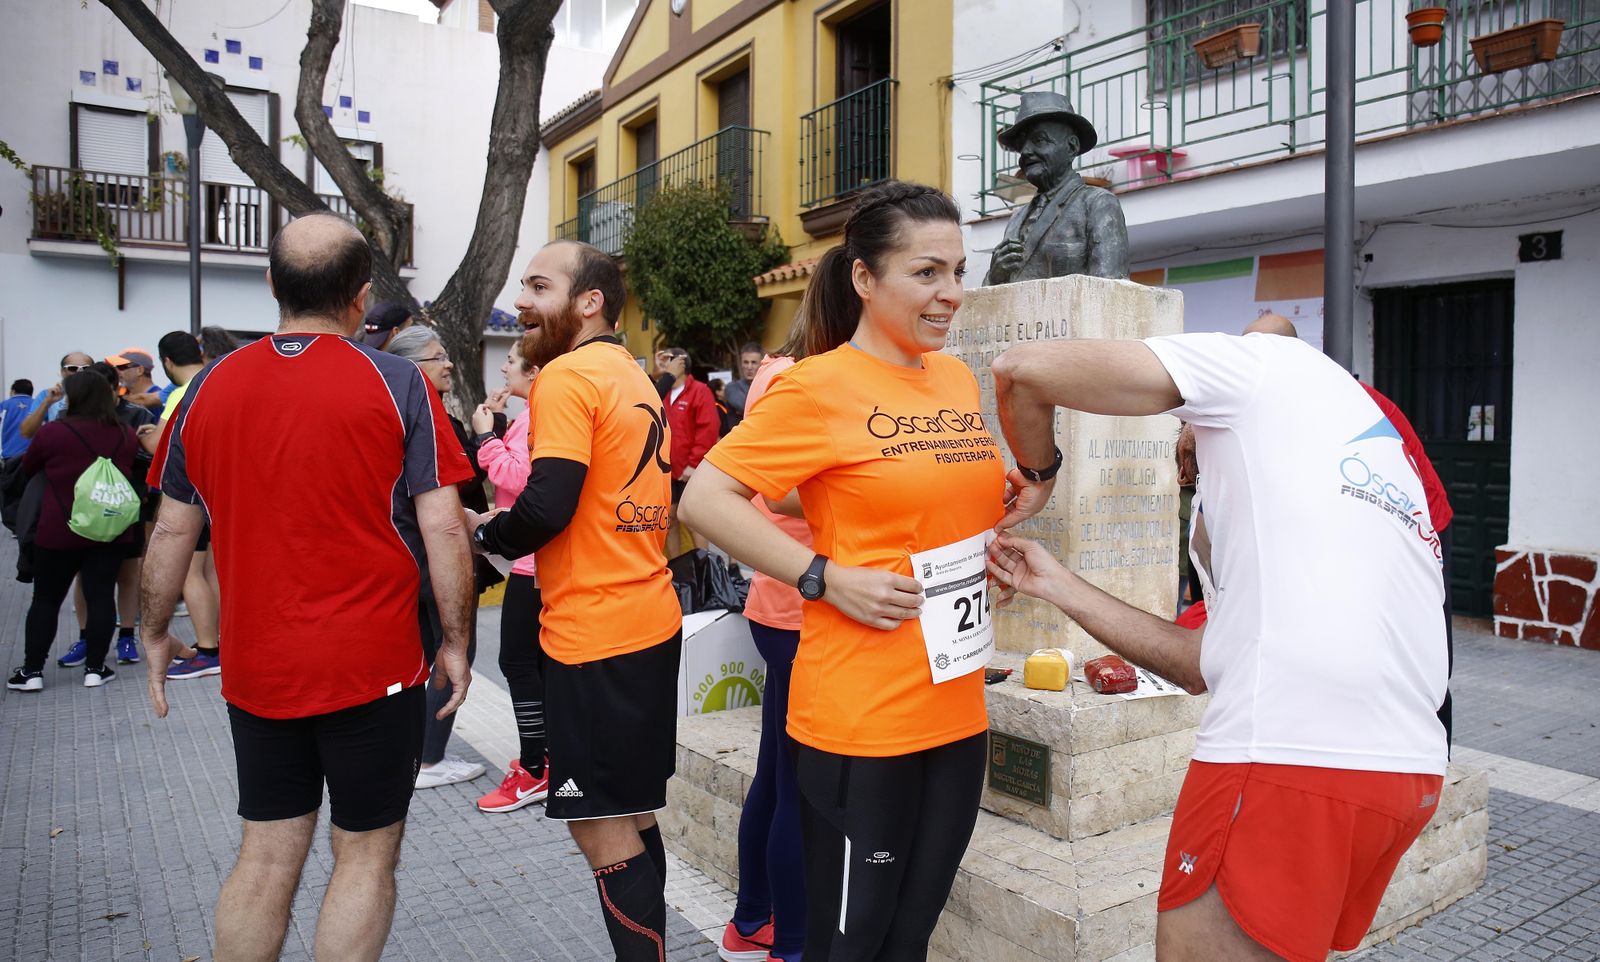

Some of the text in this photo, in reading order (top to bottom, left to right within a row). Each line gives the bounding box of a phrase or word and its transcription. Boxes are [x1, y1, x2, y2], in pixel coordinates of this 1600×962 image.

[1532, 235, 1546, 259] 3
[995, 324, 1011, 343] DE
[1017, 323, 1032, 341] EL
[1035, 319, 1068, 340] PALO
[881, 438, 974, 457] ENTRENAMIENTO
[1088, 439, 1170, 459] AL AYUNTAMIENTO
[934, 450, 997, 464] FISIOTERAPIA
[1100, 468, 1114, 486] DE
[1080, 496, 1091, 514] EL
[1081, 523, 1092, 541] DE
[1093, 523, 1105, 541] LA
[962, 647, 983, 661] CARRERA
[693, 673, 715, 702] 900
[720, 661, 744, 677] 900
[1018, 756, 1033, 767] LAS
[1030, 749, 1042, 759] DE
[993, 771, 1016, 785] MIGUEL
[1012, 765, 1039, 780] MORAS
[1005, 784, 1028, 797] NAVAS
